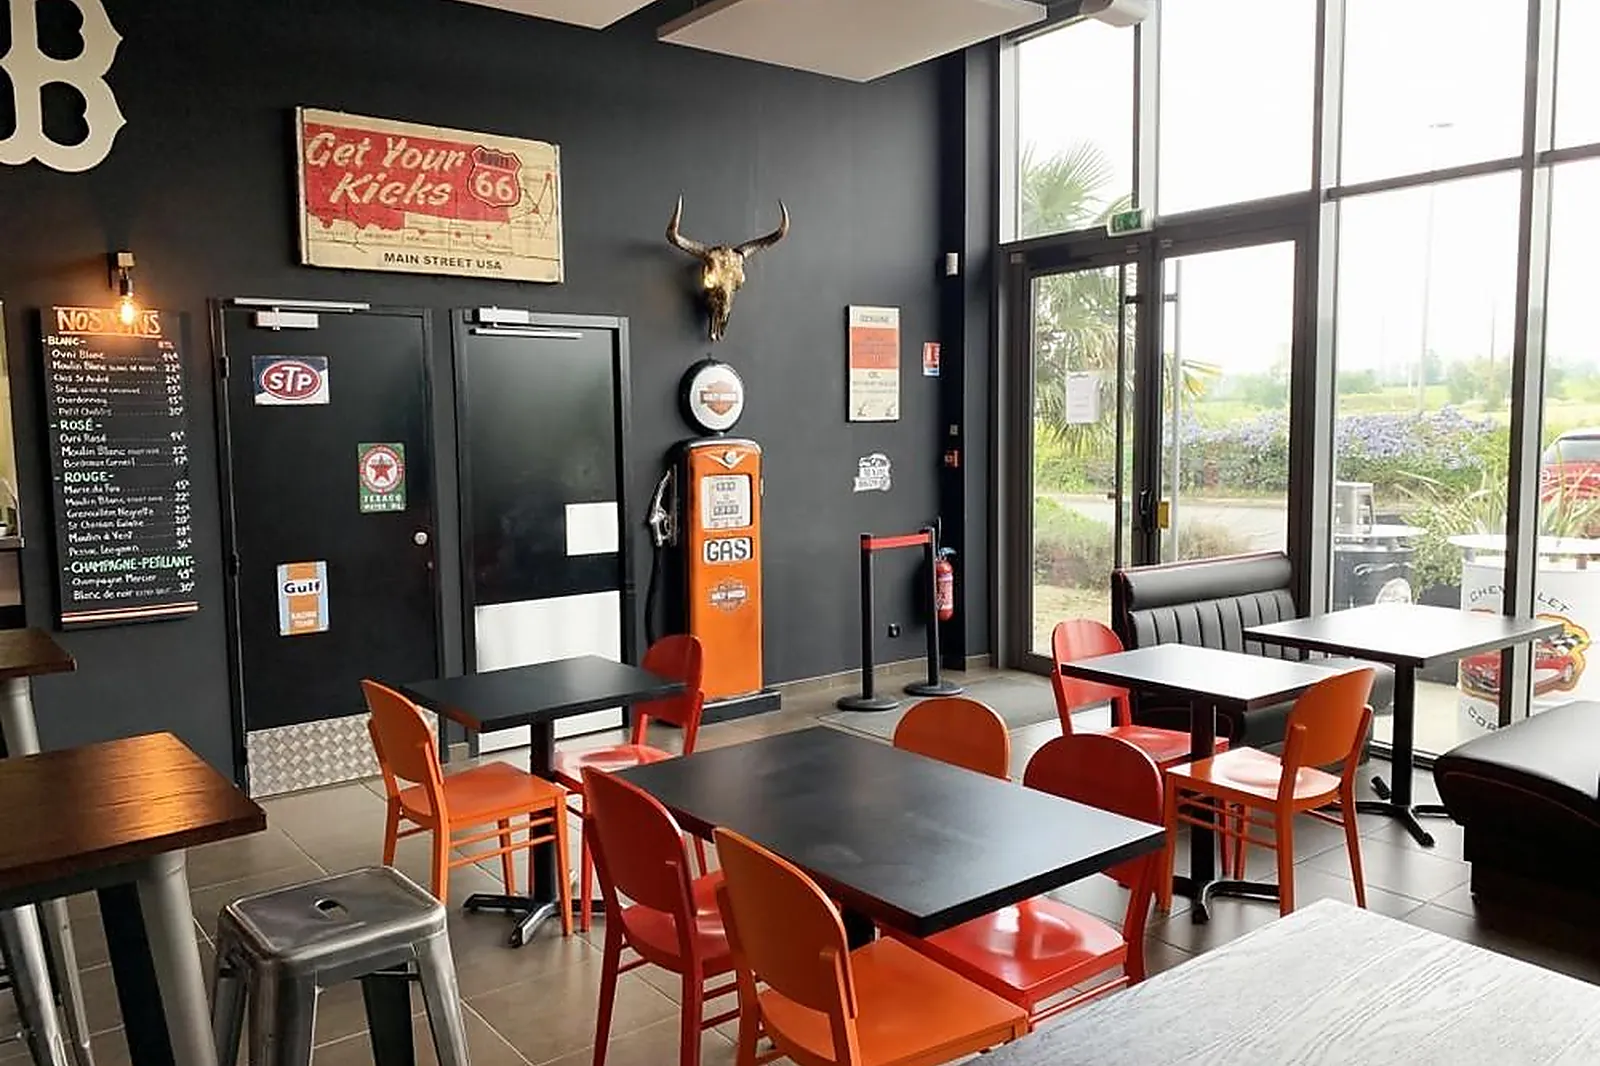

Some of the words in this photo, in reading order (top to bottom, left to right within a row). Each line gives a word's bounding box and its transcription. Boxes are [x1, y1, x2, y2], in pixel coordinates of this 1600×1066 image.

[305, 132, 371, 168] Get
[382, 136, 466, 172] Your
[328, 171, 454, 206] Kicks
[475, 171, 514, 201] 66
[384, 252, 419, 264] MAIN
[423, 255, 473, 269] STREET
[476, 259, 503, 270] USA
[57, 310, 103, 331] NOS
[269, 366, 312, 392] STP
[61, 446, 96, 457] Moulin
[707, 539, 747, 561] GAS
[73, 590, 101, 600] Blanc
[284, 581, 320, 594] Gulf
